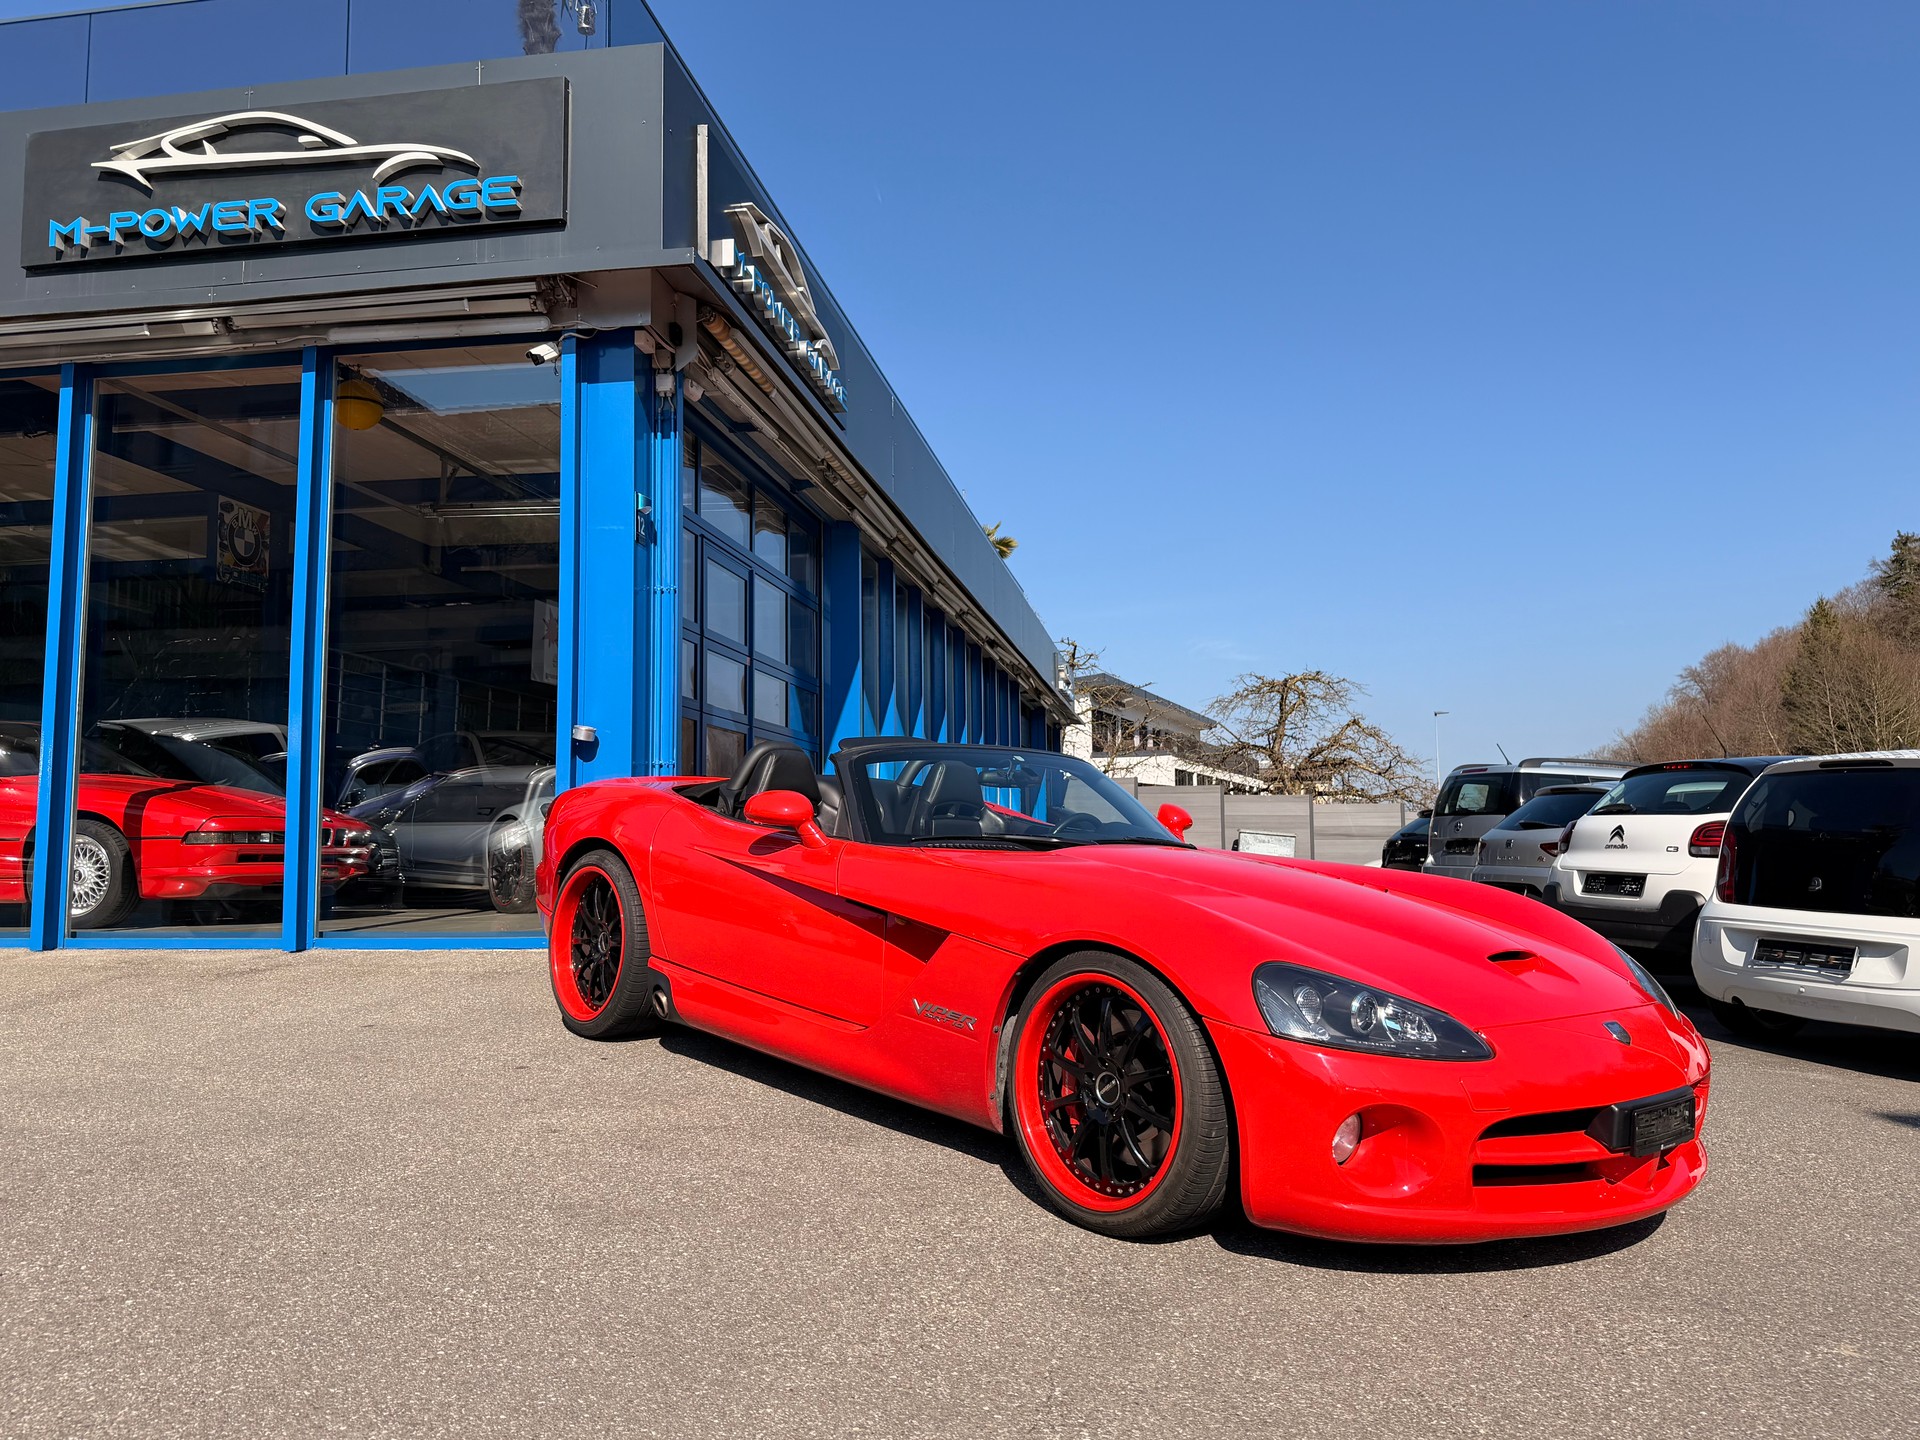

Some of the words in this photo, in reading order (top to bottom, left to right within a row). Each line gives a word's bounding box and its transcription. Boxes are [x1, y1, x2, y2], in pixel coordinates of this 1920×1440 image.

[48, 197, 280, 248] M-POWER
[304, 175, 518, 222] GARAGE
[1666, 845, 1679, 853] C3
[911, 997, 978, 1031] VIPER
